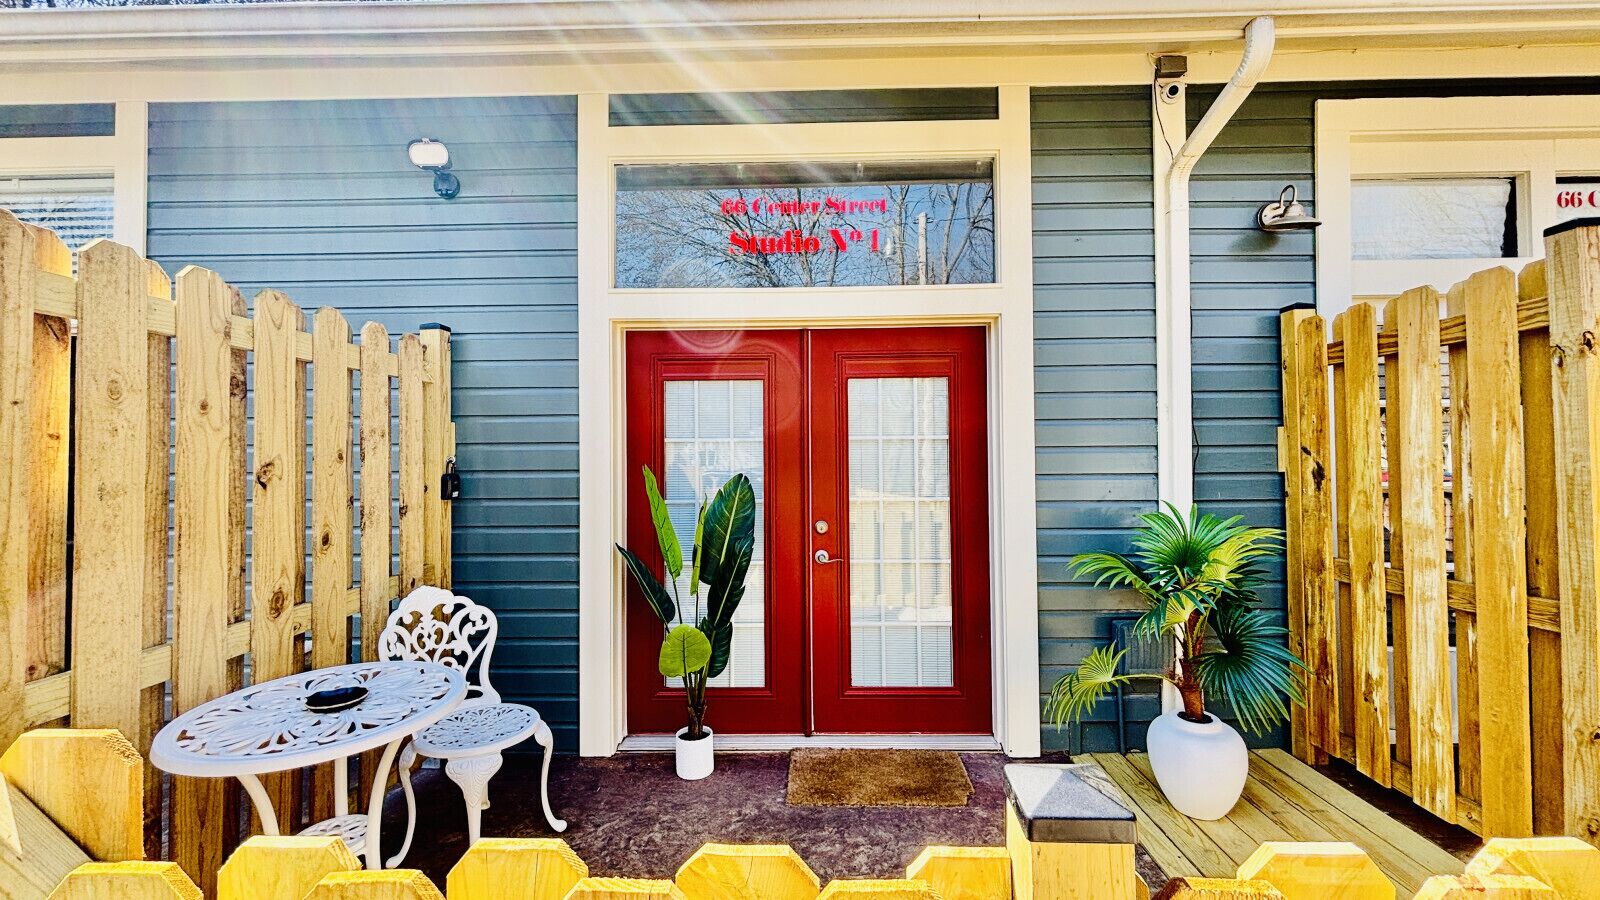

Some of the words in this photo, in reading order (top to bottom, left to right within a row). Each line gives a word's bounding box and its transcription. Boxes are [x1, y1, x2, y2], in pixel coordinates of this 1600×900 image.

[720, 197, 748, 215] 66
[752, 196, 820, 215] Center
[824, 196, 887, 215] Street
[1556, 191, 1583, 208] 66
[728, 228, 820, 255] Studio
[870, 228, 880, 253] 1
